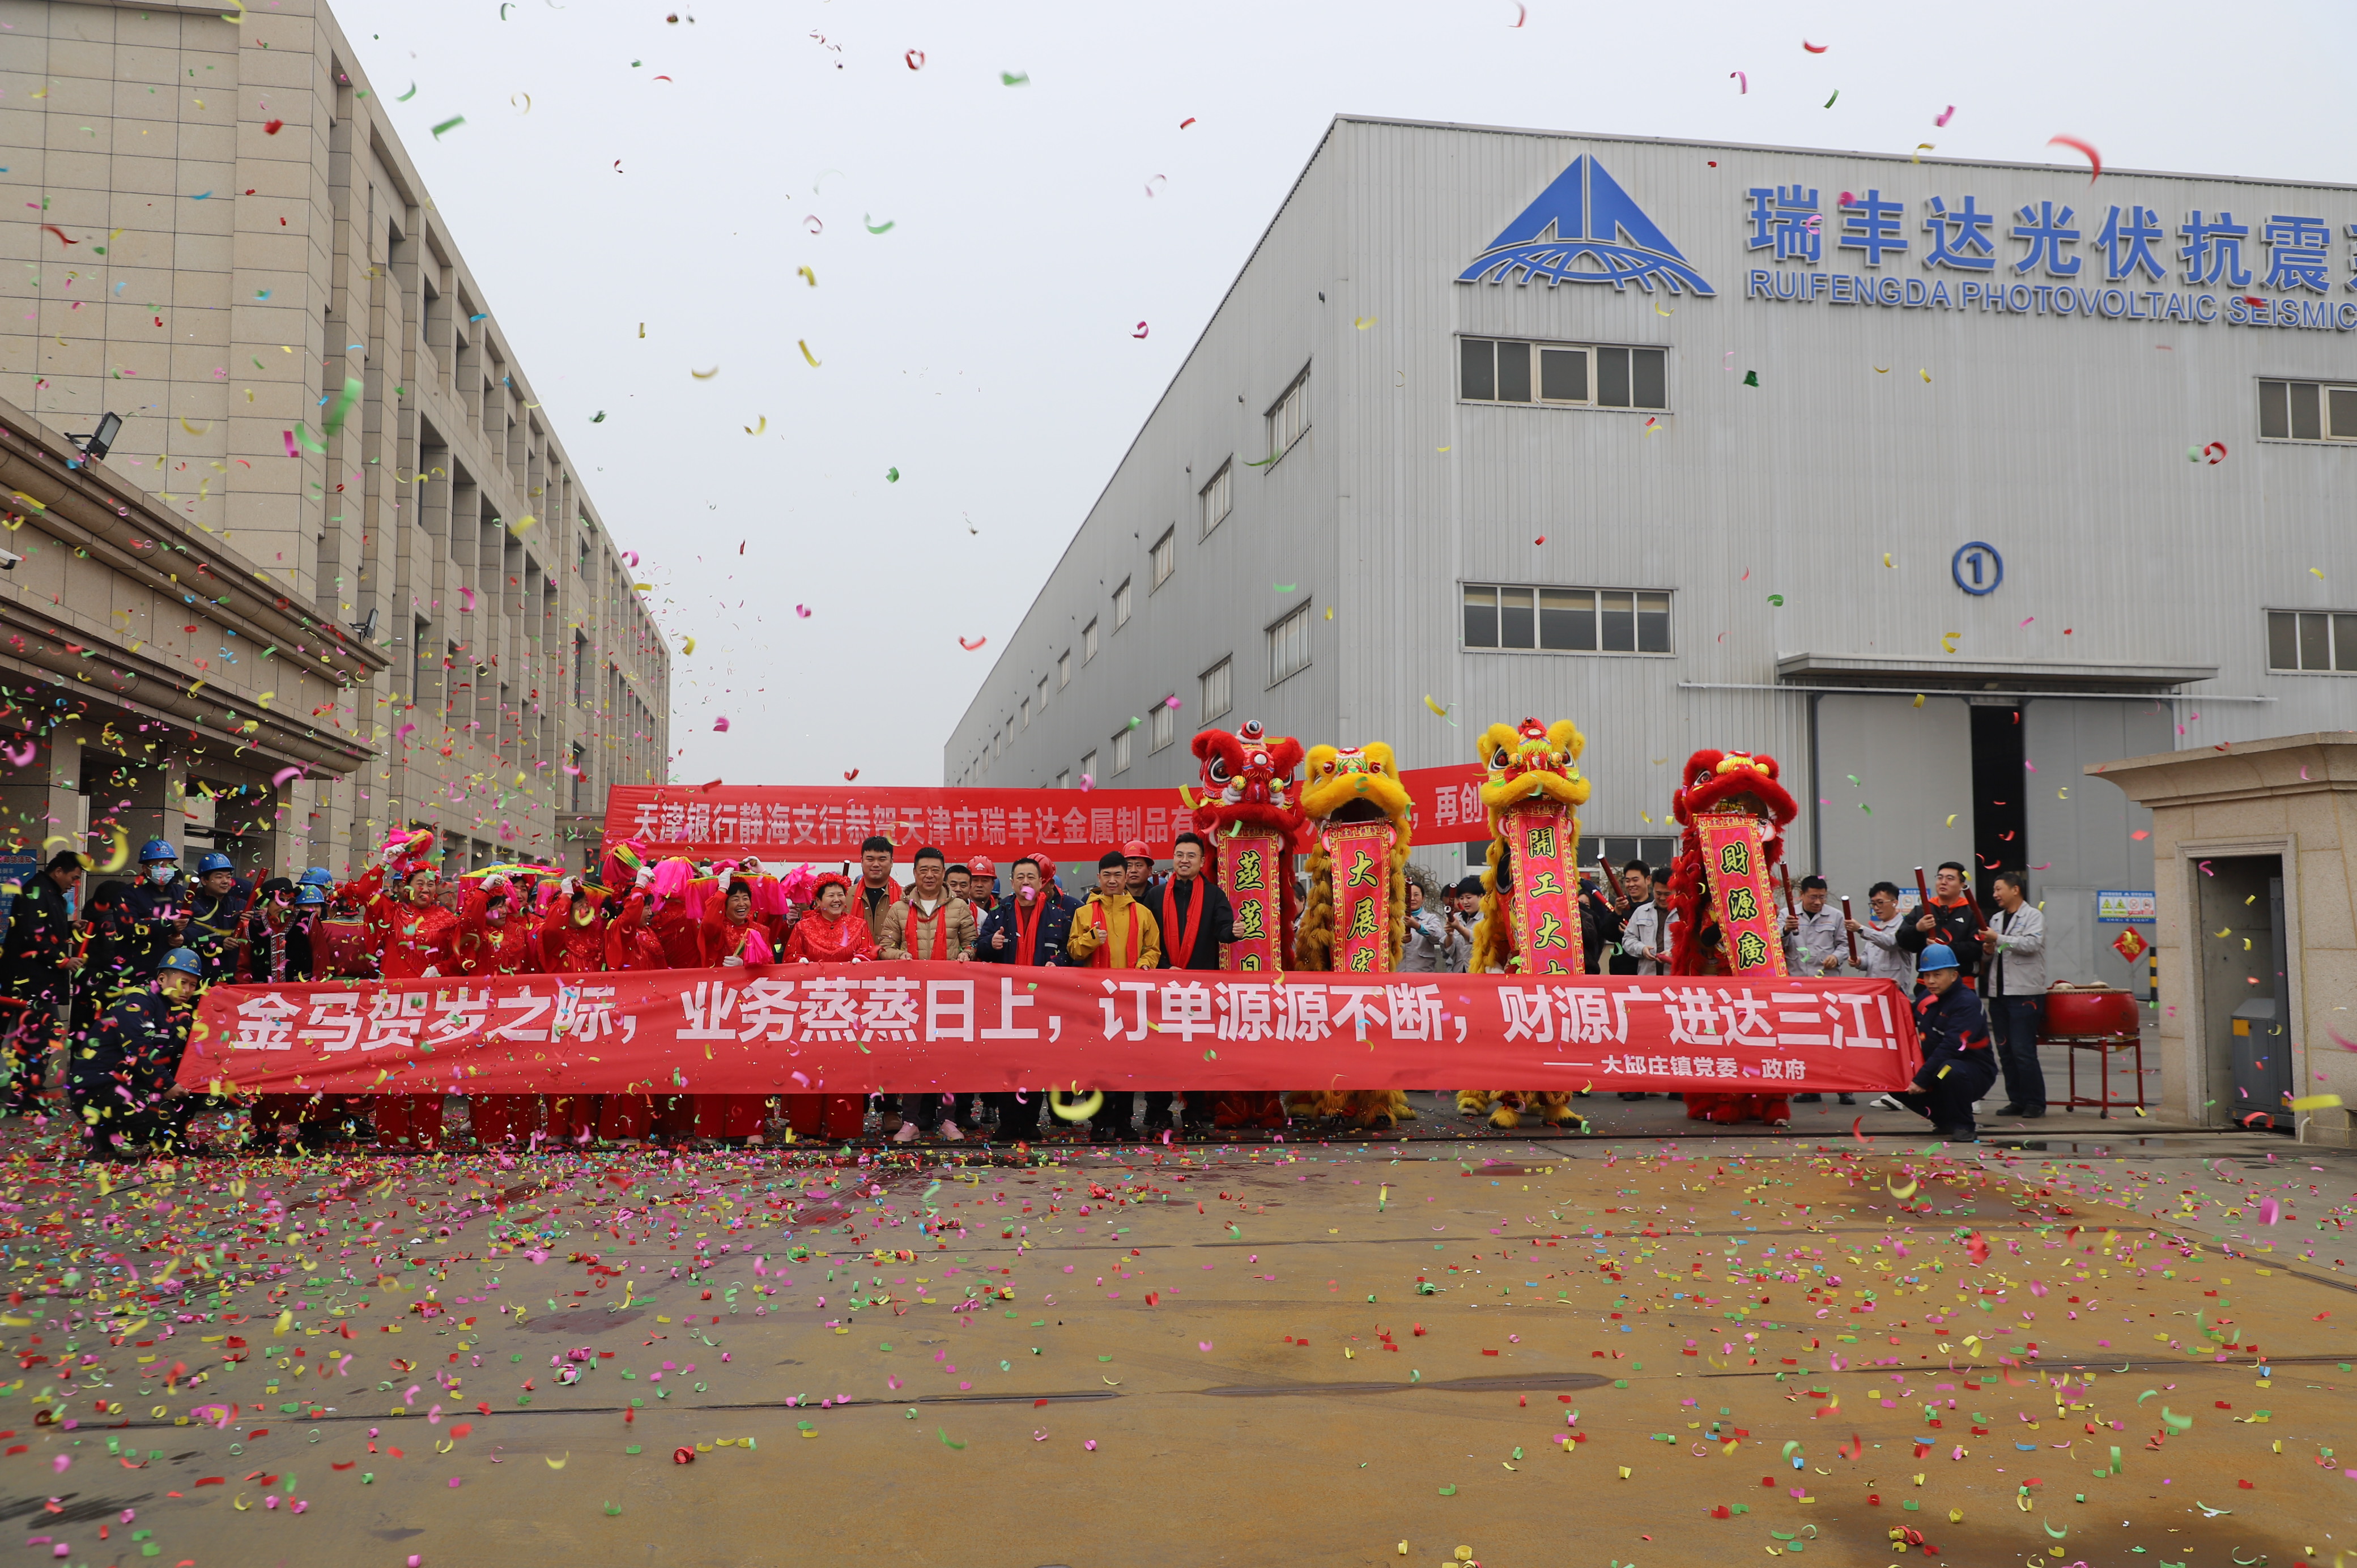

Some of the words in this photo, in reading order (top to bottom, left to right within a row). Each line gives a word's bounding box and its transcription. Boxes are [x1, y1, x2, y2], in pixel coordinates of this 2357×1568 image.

[1746, 184, 2357, 294] 瑞丰达光伏抗震
[1747, 269, 1953, 309] RUIFENGDA
[1959, 281, 2218, 323] PHOTOVOLTAIC
[2225, 295, 2357, 331] SEISMIC
